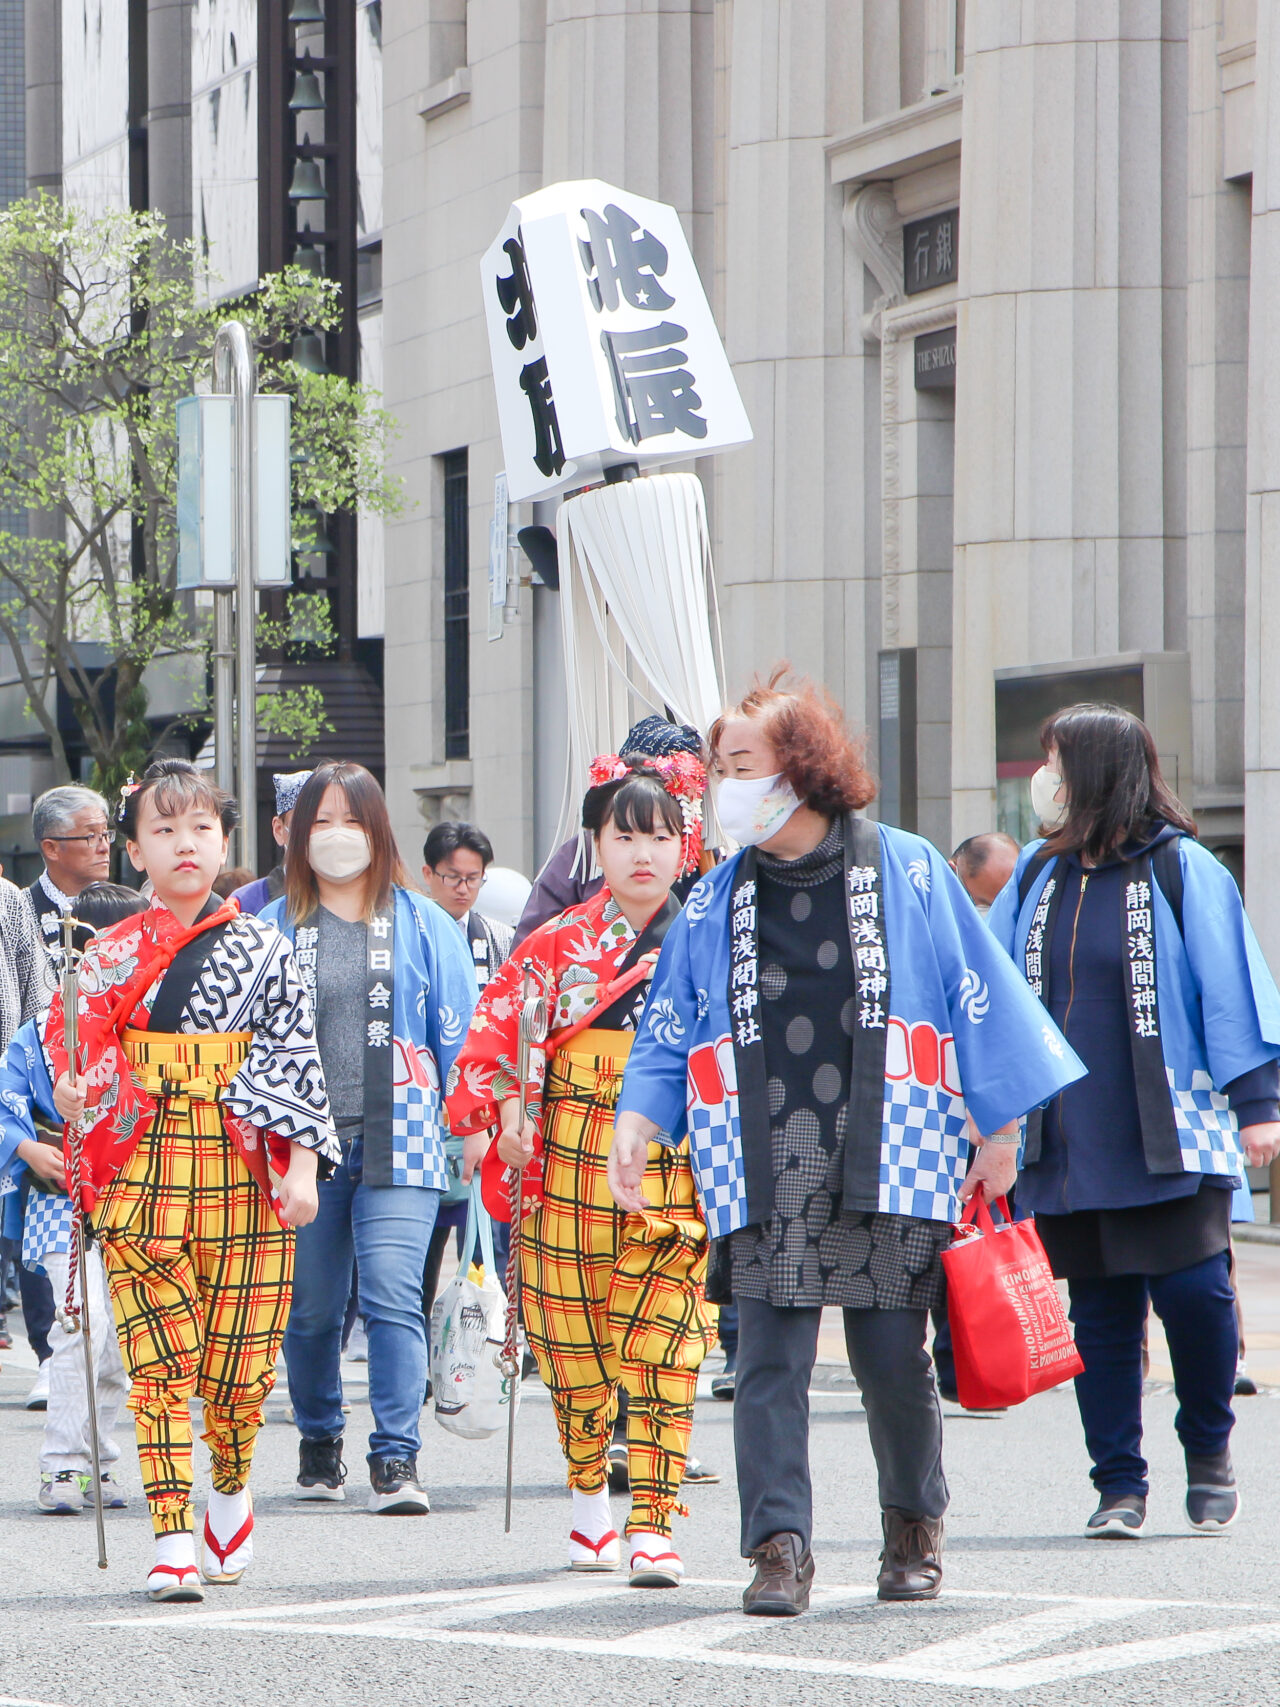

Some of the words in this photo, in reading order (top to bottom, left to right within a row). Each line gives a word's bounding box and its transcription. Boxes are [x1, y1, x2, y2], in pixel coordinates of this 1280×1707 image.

[367, 916, 392, 1048] 廿日会祭
[732, 879, 762, 1048] 静岡浅間神社
[847, 865, 888, 1030] 静岡浅間神社
[1125, 880, 1159, 1038] 静岡浅間神社
[1005, 1286, 1040, 1369] KINOKUNIYA
[1021, 1294, 1046, 1352] KINOKUNIYA
